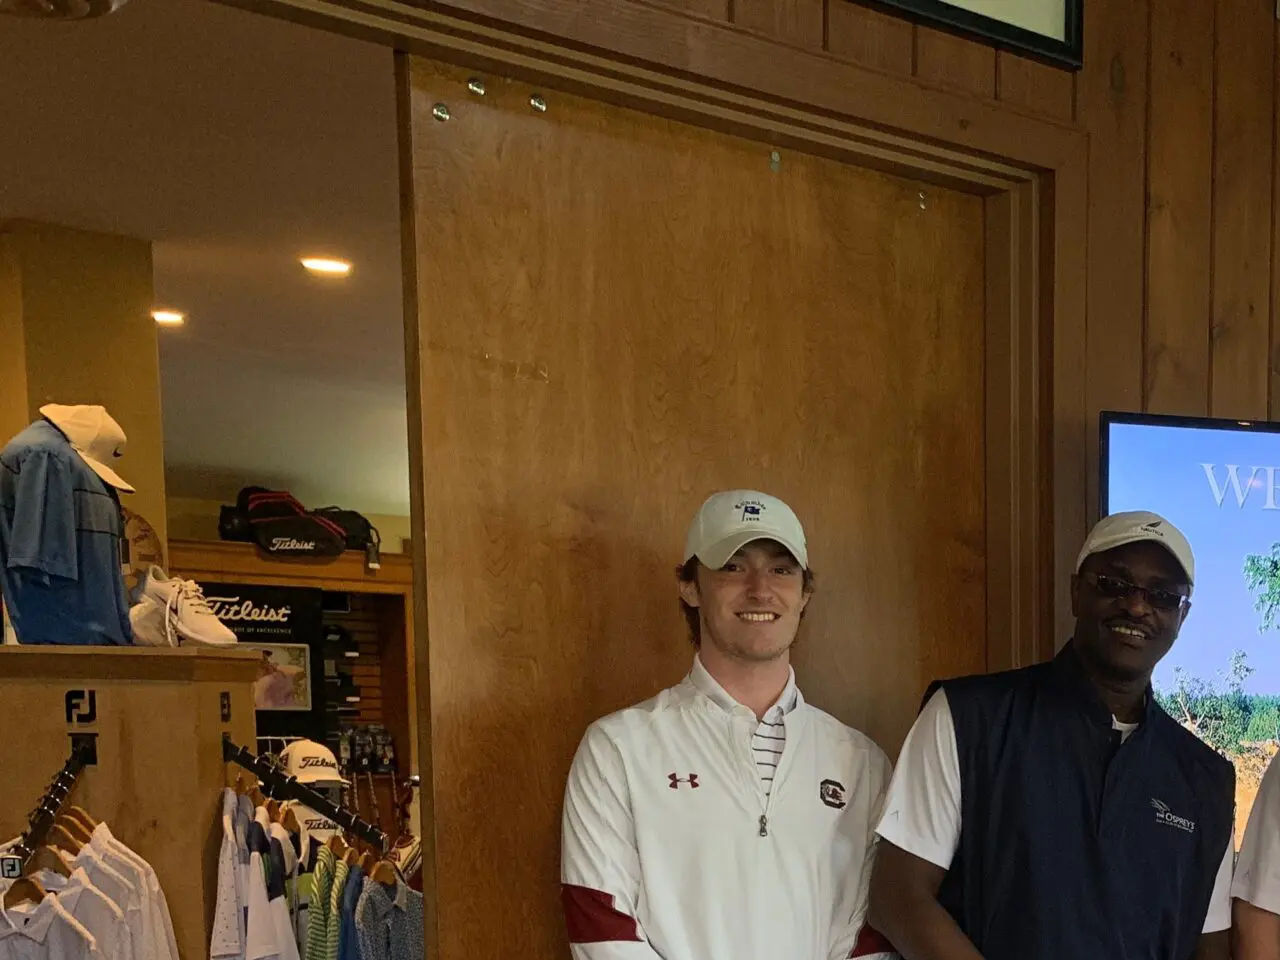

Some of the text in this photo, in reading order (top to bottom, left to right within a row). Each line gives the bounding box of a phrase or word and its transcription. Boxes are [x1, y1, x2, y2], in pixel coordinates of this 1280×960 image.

[269, 536, 316, 551] Titleist
[204, 596, 292, 622] Titleist
[65, 689, 97, 723] FJ
